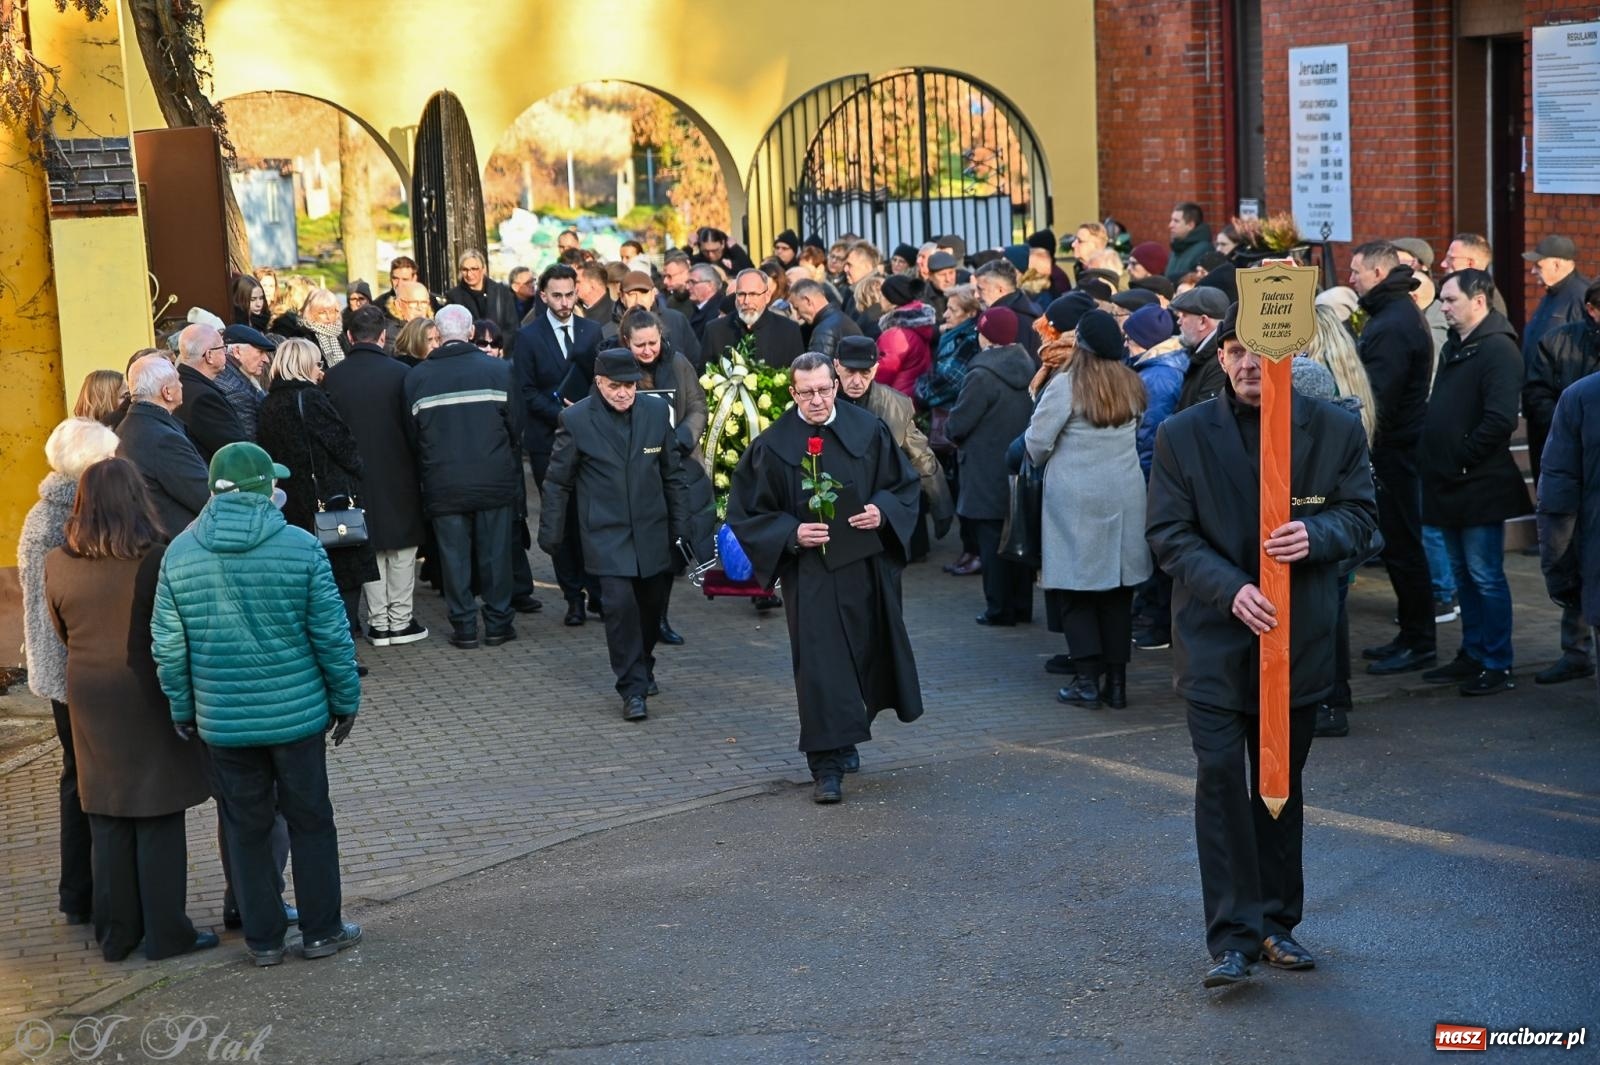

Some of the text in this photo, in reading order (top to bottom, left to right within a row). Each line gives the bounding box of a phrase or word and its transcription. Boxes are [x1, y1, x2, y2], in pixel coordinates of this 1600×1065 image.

[1299, 60, 1338, 75] Jeruzalem
[1261, 291, 1294, 301] Tadeusz
[1260, 302, 1293, 315] Ekiert
